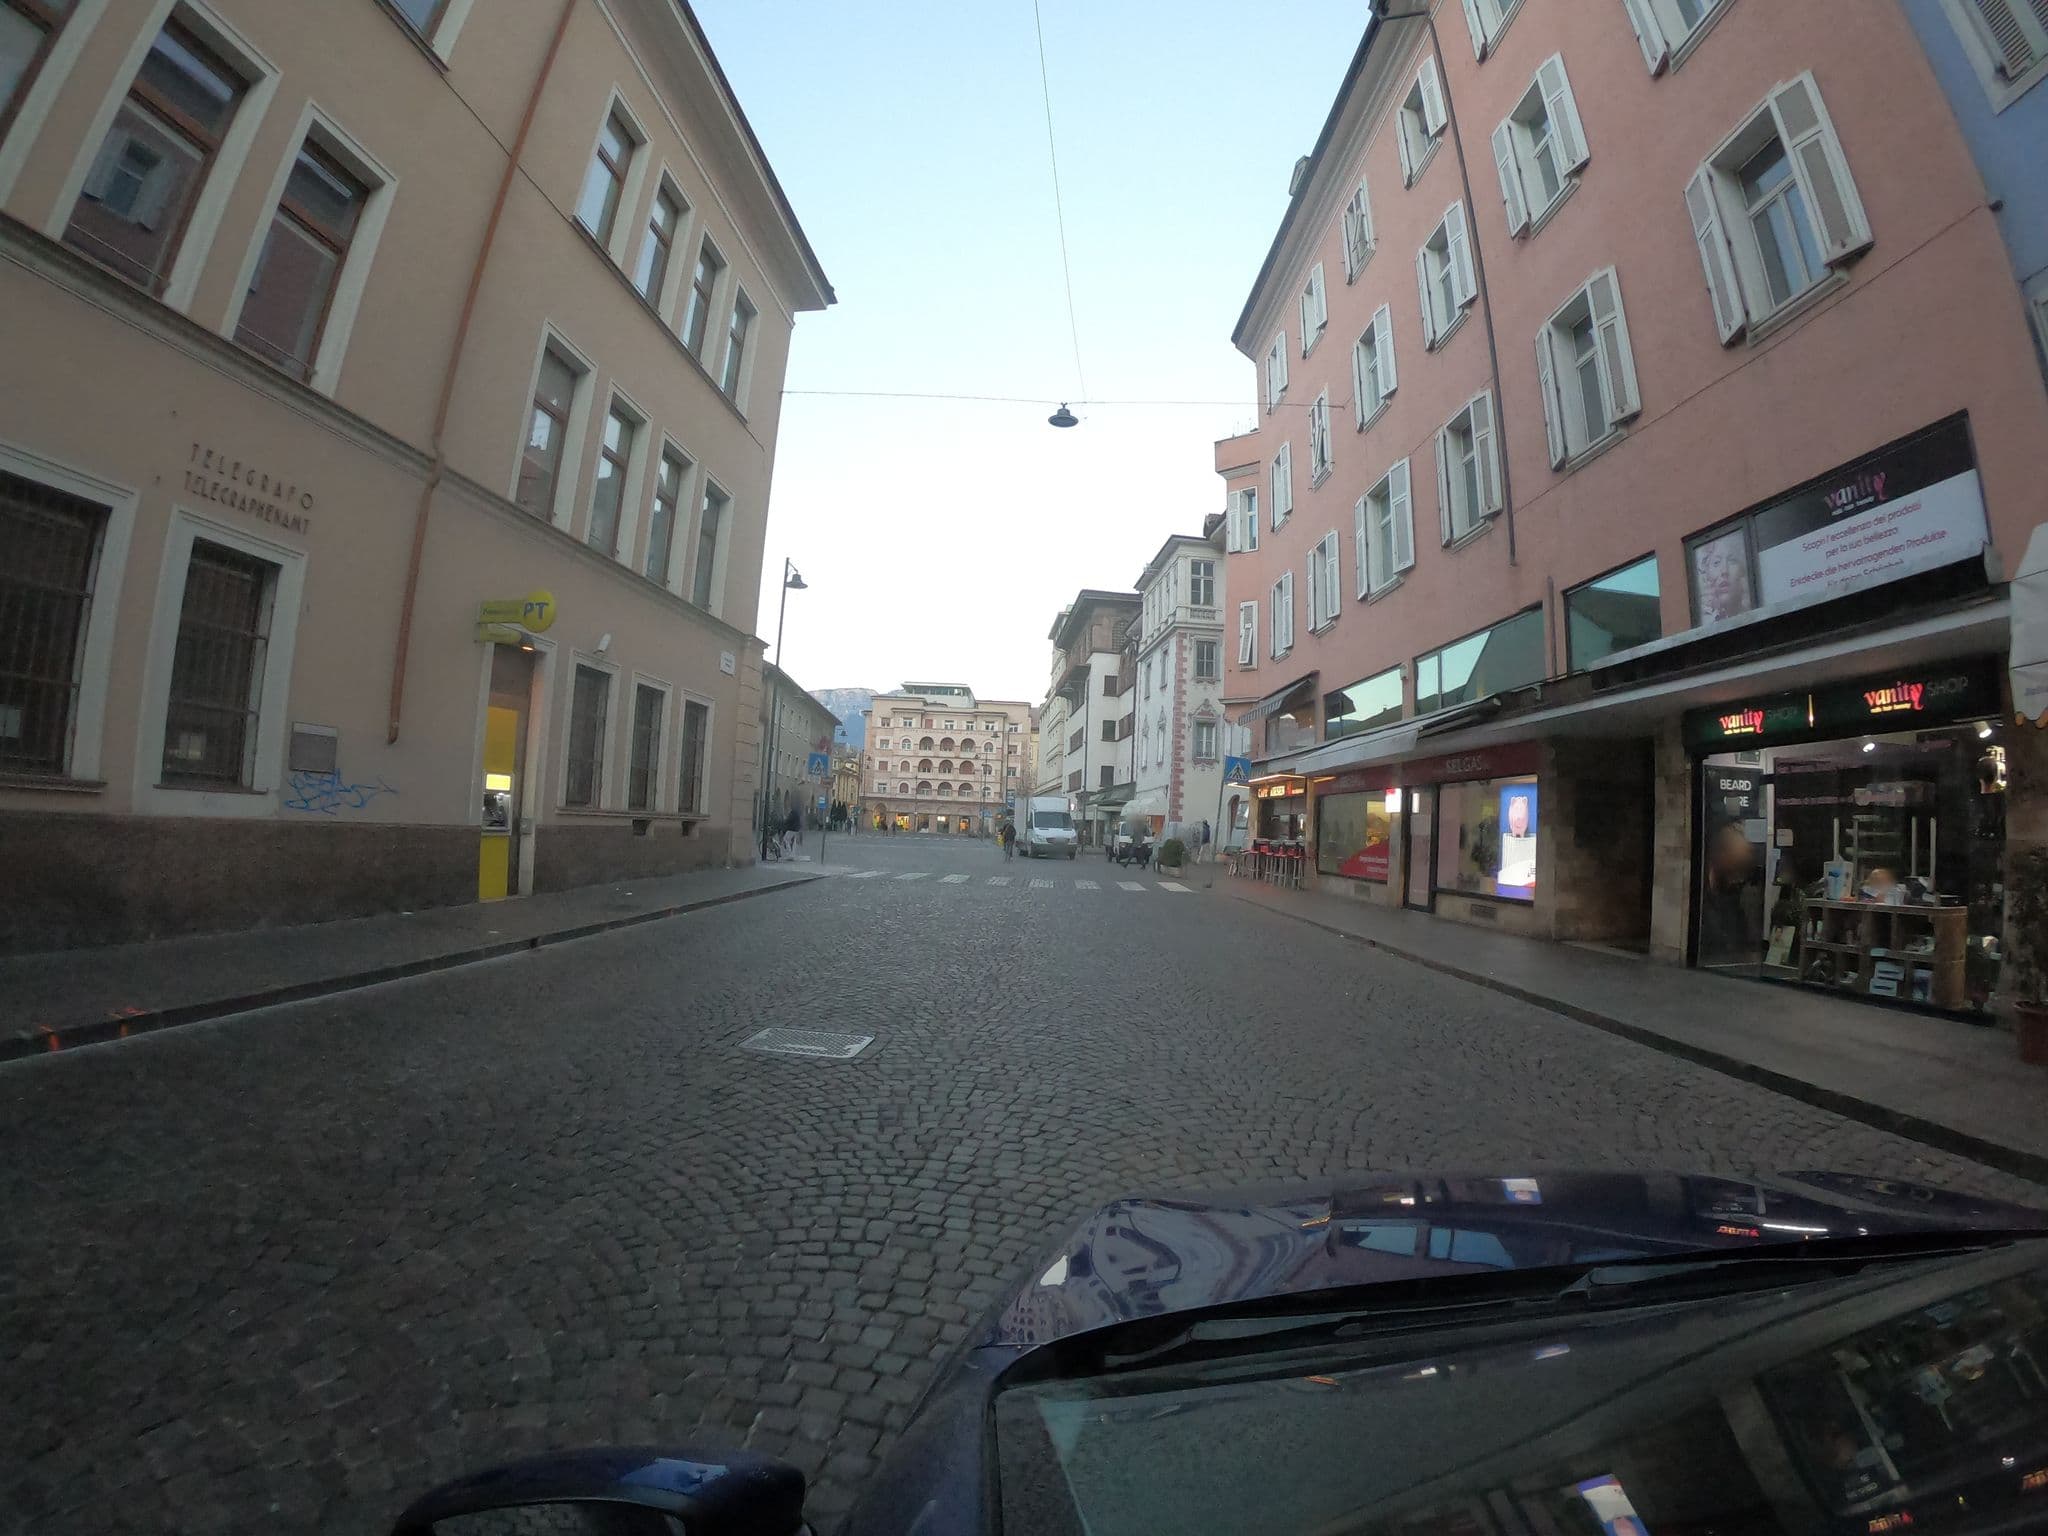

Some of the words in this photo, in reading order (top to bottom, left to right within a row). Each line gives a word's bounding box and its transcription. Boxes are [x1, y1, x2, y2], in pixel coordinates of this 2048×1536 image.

[191, 443, 314, 510] TELEGRAFO
[1823, 471, 1888, 511] vanity
[184, 470, 310, 535] TELEGRAPHENAMT
[1802, 537, 1826, 552] Scopri
[1873, 515, 1887, 526] dei
[1825, 548, 1840, 560] per
[1863, 526, 1899, 545] bellezza
[1906, 529, 1948, 549] Produkte
[1863, 681, 1925, 710] vanity
[1718, 708, 1764, 734] vanity
[1720, 779, 1752, 791] BEARD
[1723, 796, 1750, 807] RE
